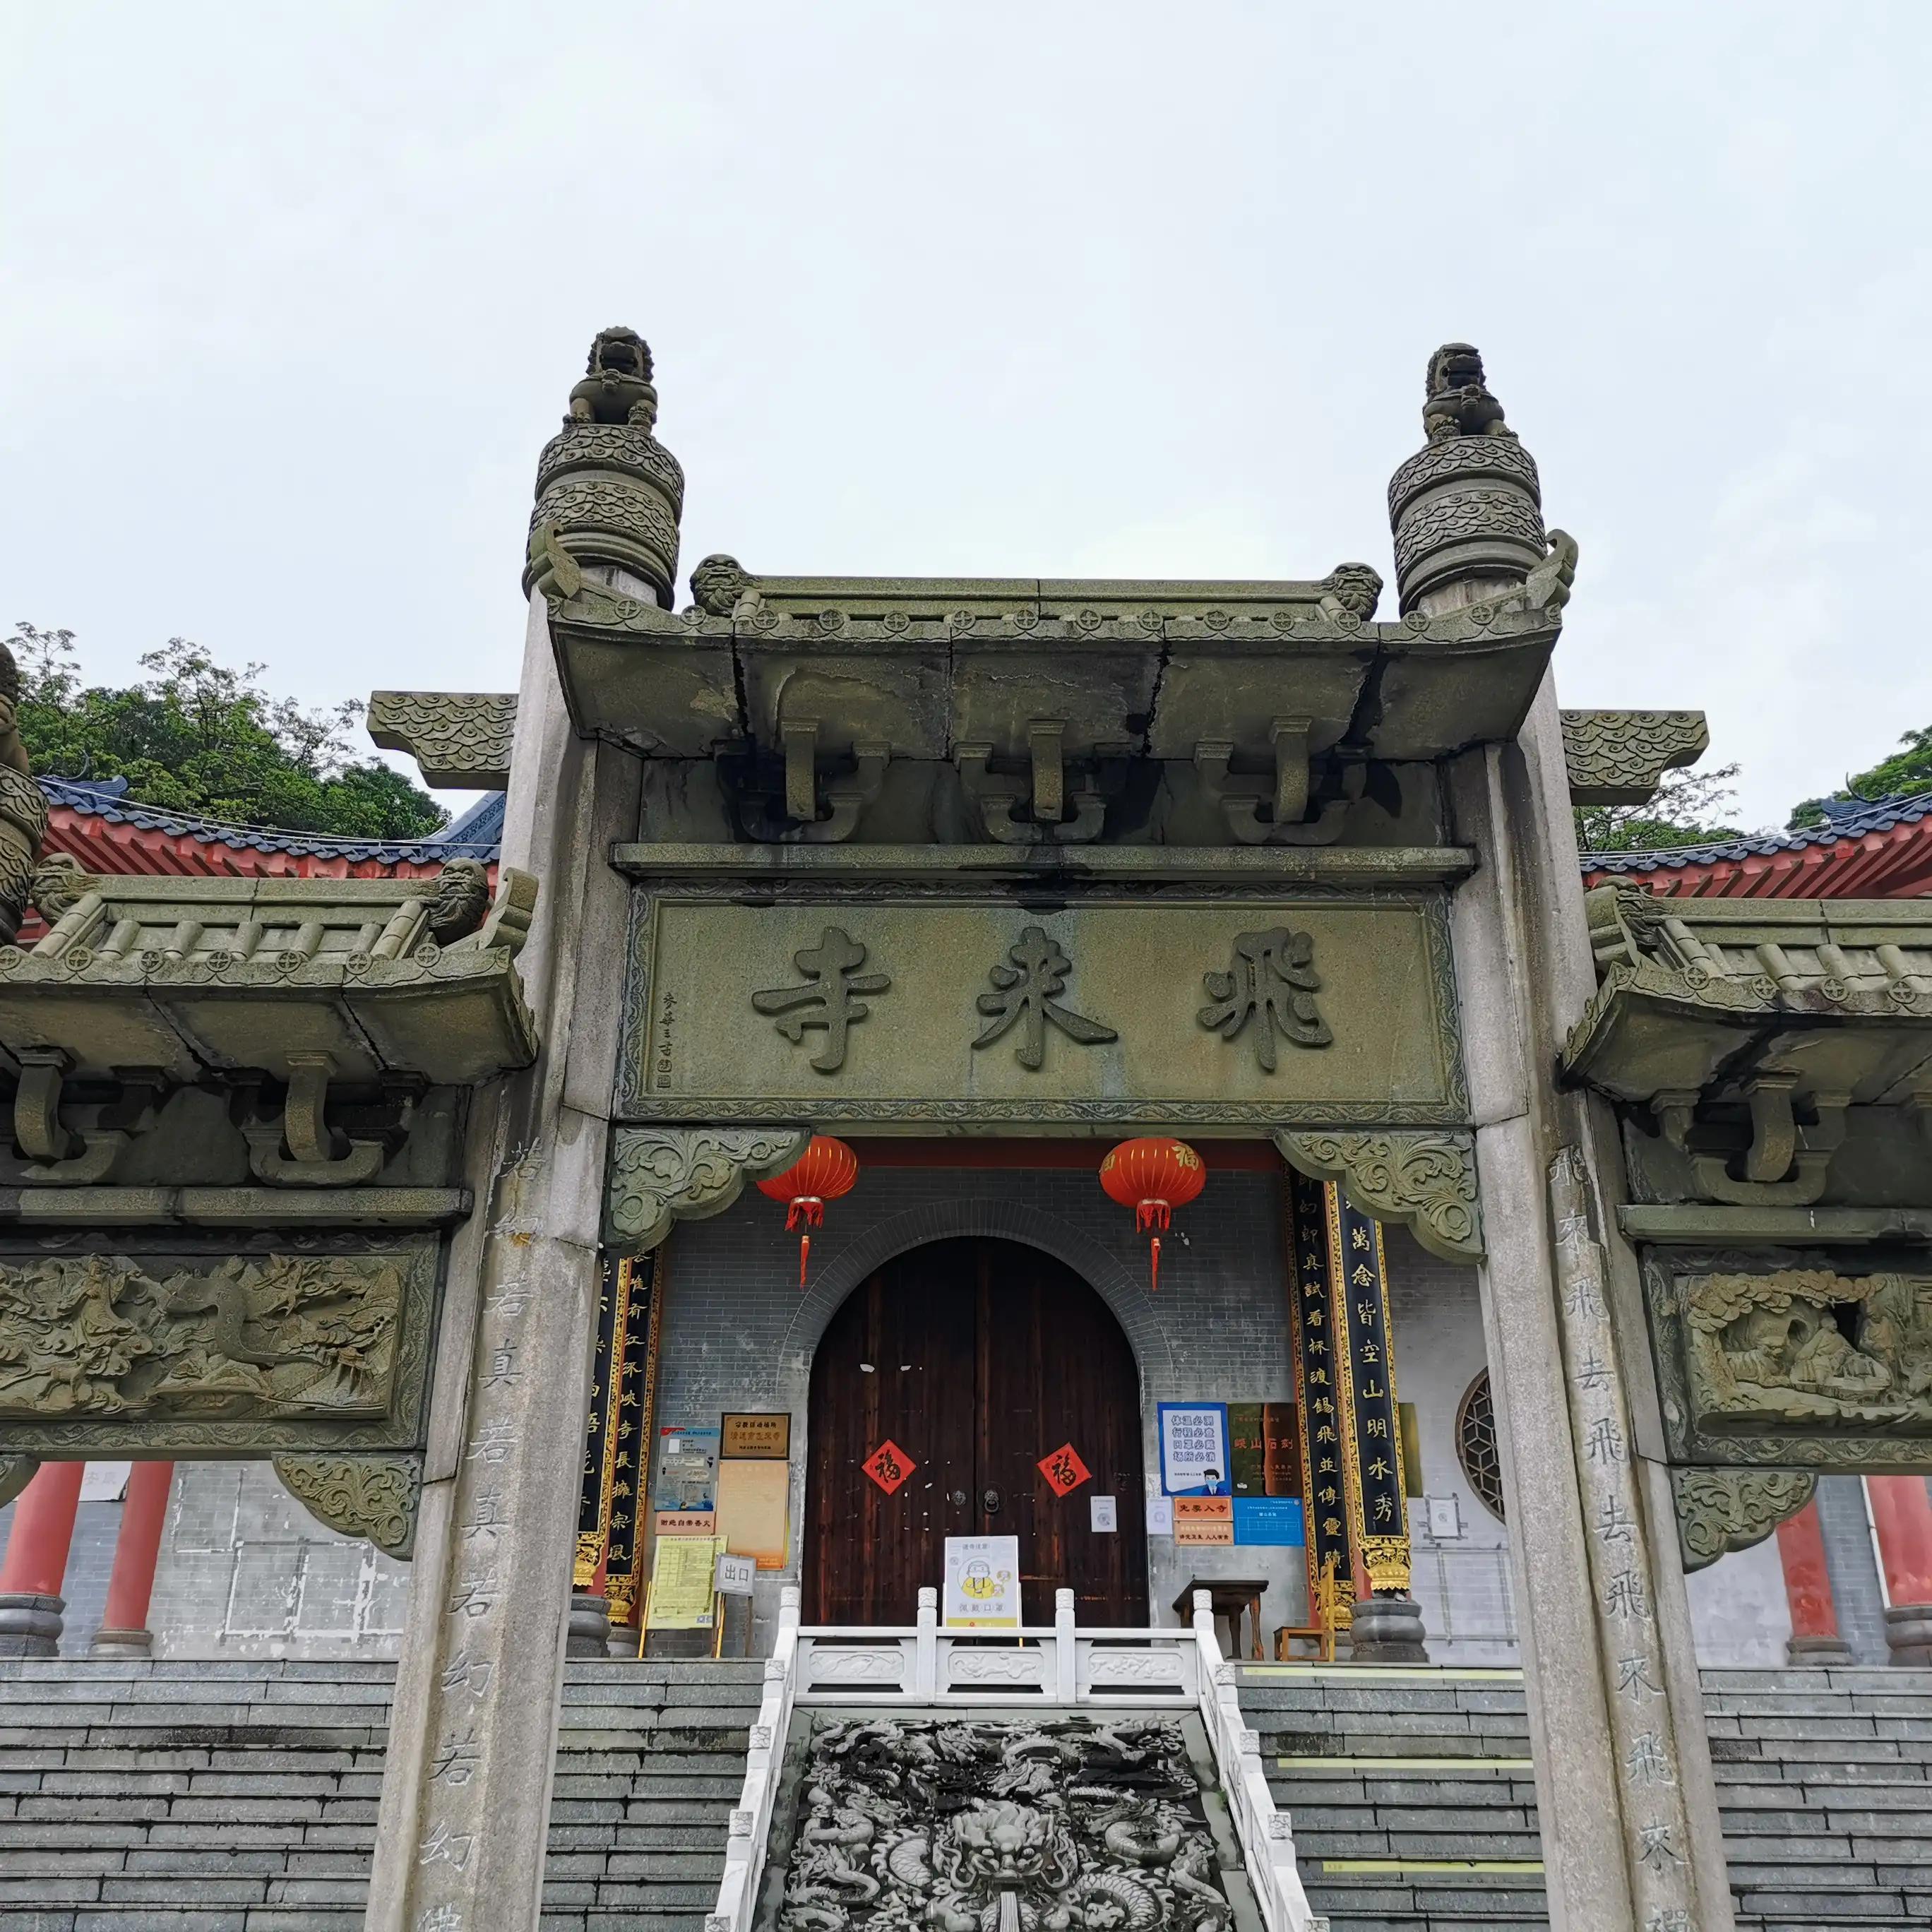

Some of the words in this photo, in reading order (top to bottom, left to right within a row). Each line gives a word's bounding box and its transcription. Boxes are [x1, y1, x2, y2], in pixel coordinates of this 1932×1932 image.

[1171, 1143, 1199, 1171] 福
[1345, 1200, 1394, 1522] 萬念皆空山明水秀
[875, 1448, 901, 1482] 福
[1051, 1452, 1077, 1486] 福
[724, 1564, 749, 1582] 出口
